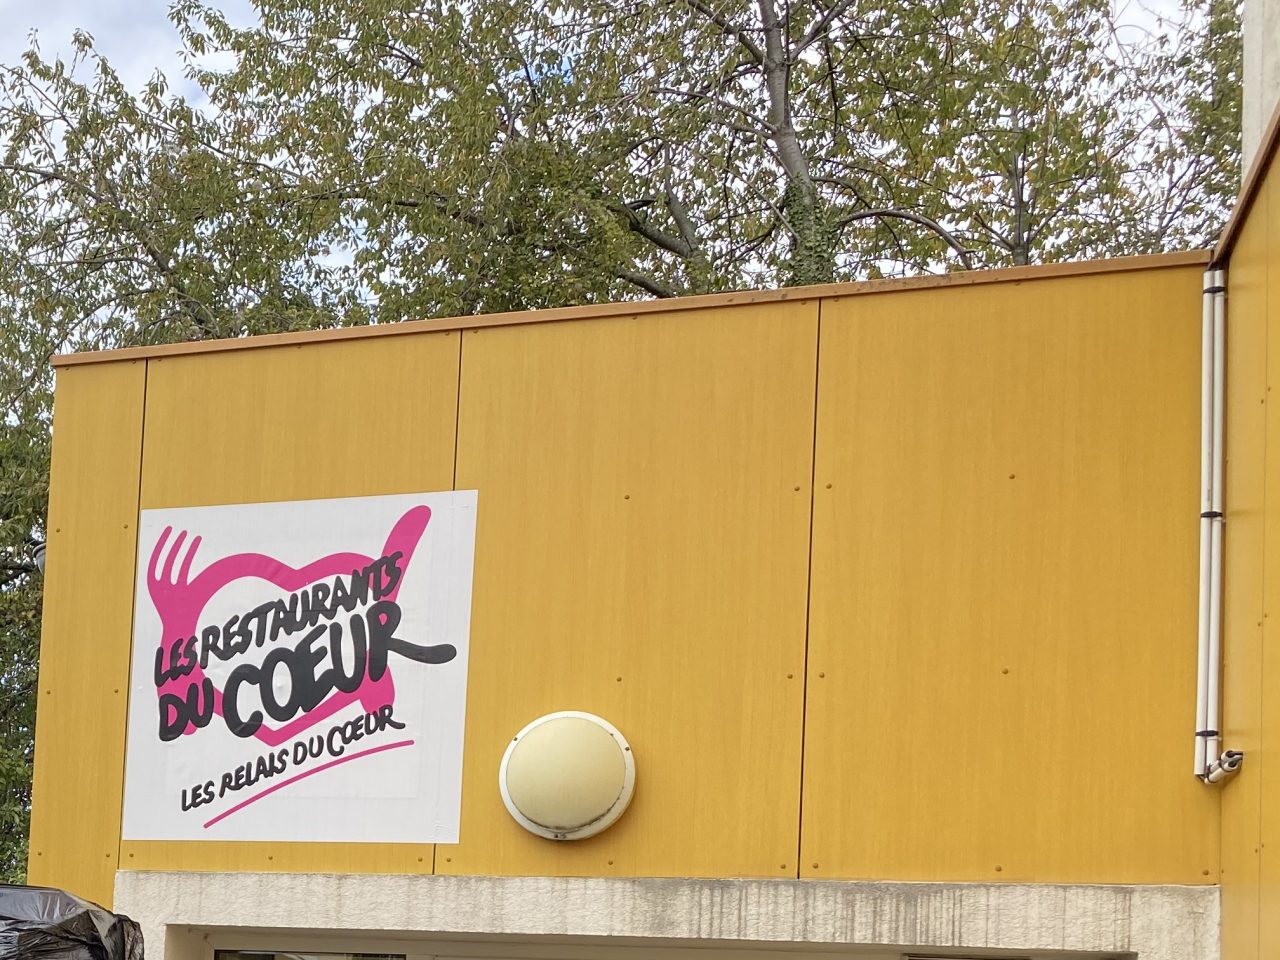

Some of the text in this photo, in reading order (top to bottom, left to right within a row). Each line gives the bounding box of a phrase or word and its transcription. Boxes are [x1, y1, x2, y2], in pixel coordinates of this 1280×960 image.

[154, 551, 403, 688] LES RESTAURANTS
[158, 677, 215, 742] DU
[182, 781, 216, 811] LES
[219, 749, 290, 798] RELAIS
[292, 735, 325, 766] DU
